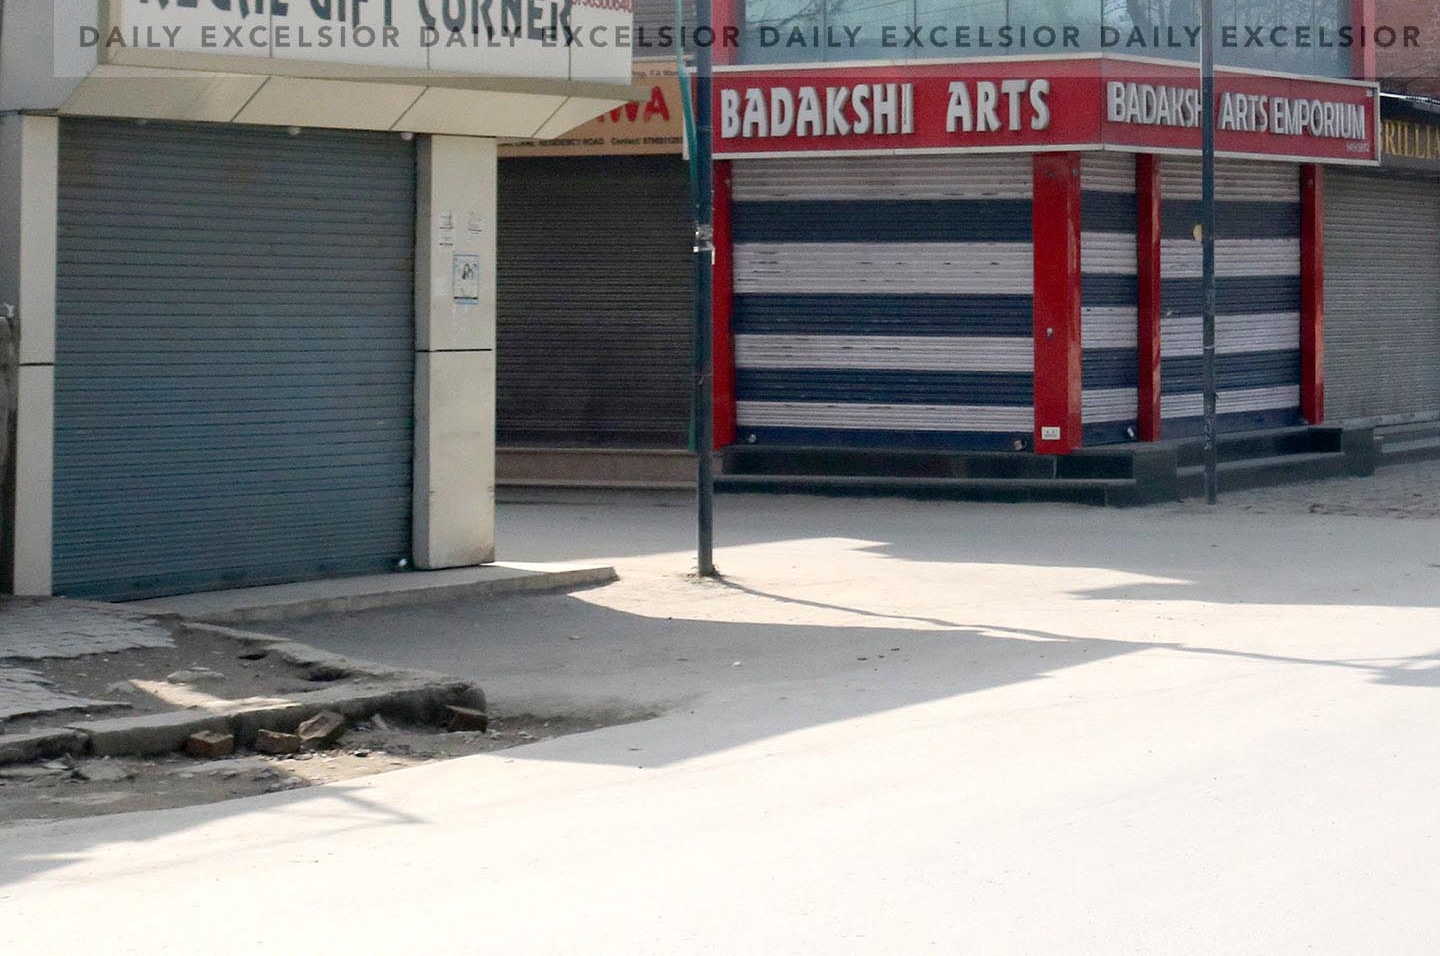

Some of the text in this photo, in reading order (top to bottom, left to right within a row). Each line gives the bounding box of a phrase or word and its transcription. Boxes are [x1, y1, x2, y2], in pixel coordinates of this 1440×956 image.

[721, 78, 1050, 139] BADAKSHI ARTS
[1107, 81, 1366, 140] BADAKSH ARTS EMPORIUM
